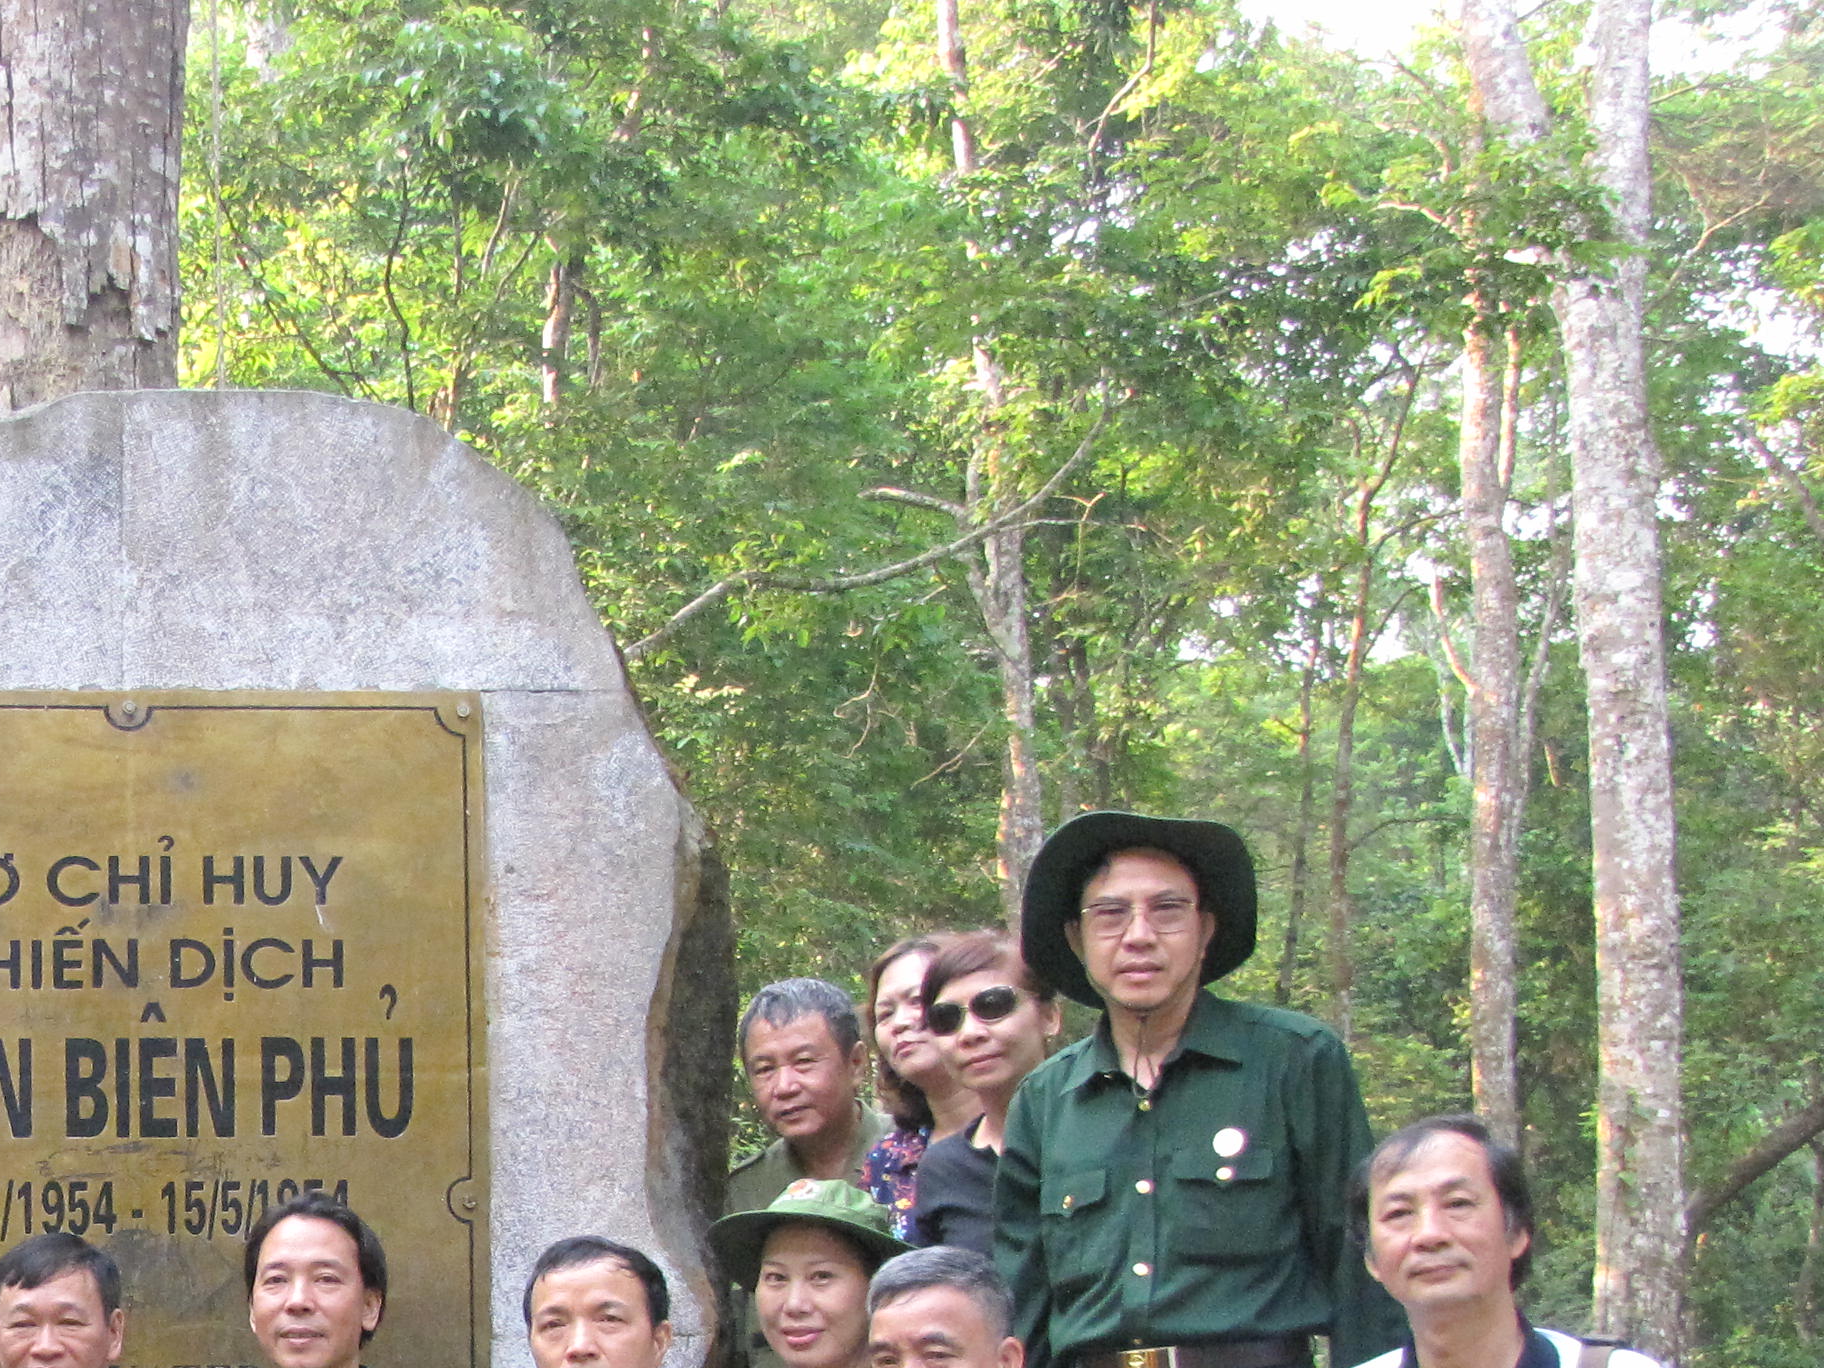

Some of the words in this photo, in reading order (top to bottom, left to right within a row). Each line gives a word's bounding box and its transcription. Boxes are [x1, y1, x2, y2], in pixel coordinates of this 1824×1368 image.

[46, 835, 174, 906] CHỈ
[202, 855, 344, 905] HUY
[169, 927, 345, 1002] DỊCH
[65, 1002, 236, 1138] BIÊN
[261, 983, 414, 1139] PHỦ
[161, 1178, 348, 1241] 15/5/14
